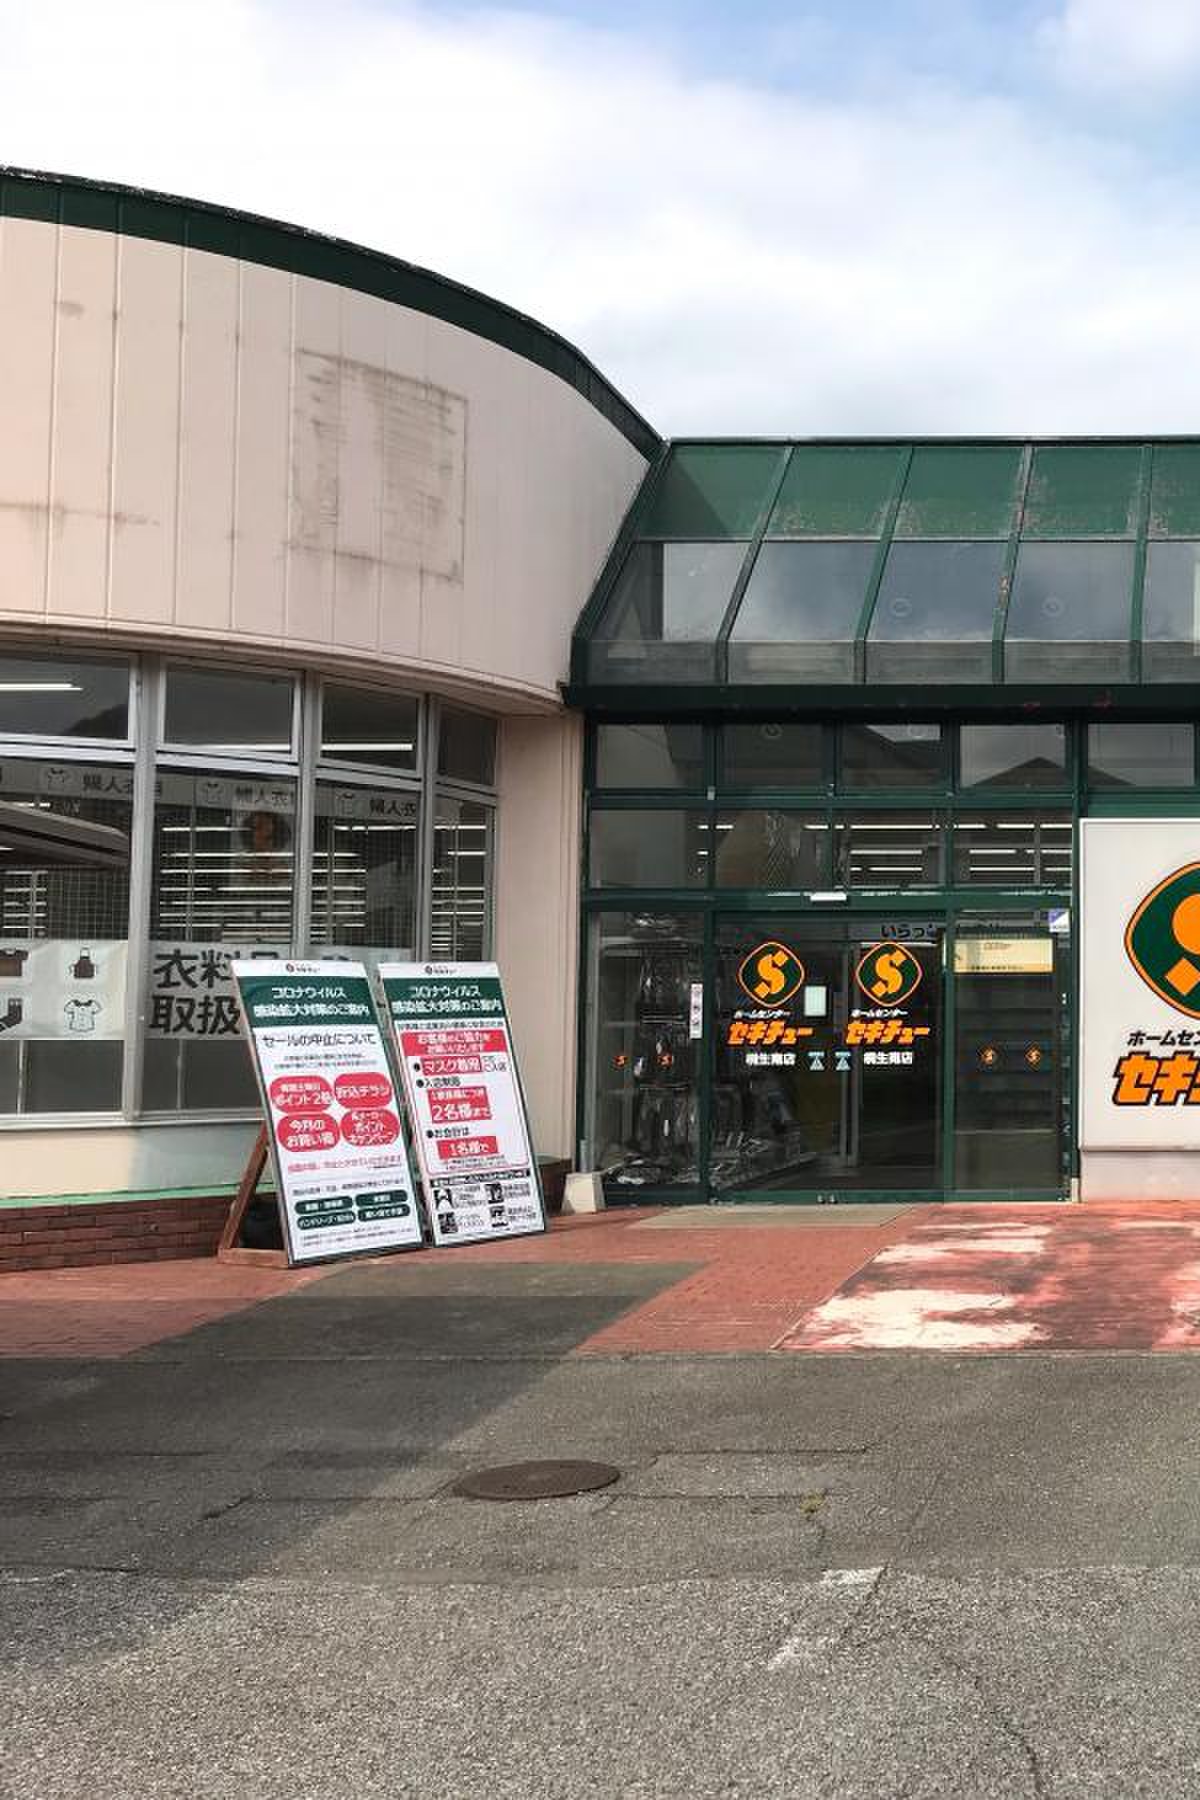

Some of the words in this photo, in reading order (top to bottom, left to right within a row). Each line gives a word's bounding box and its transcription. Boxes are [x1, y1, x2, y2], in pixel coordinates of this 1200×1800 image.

[727, 1019, 813, 1045] セキチュー
[845, 1019, 931, 1045] セキチュー
